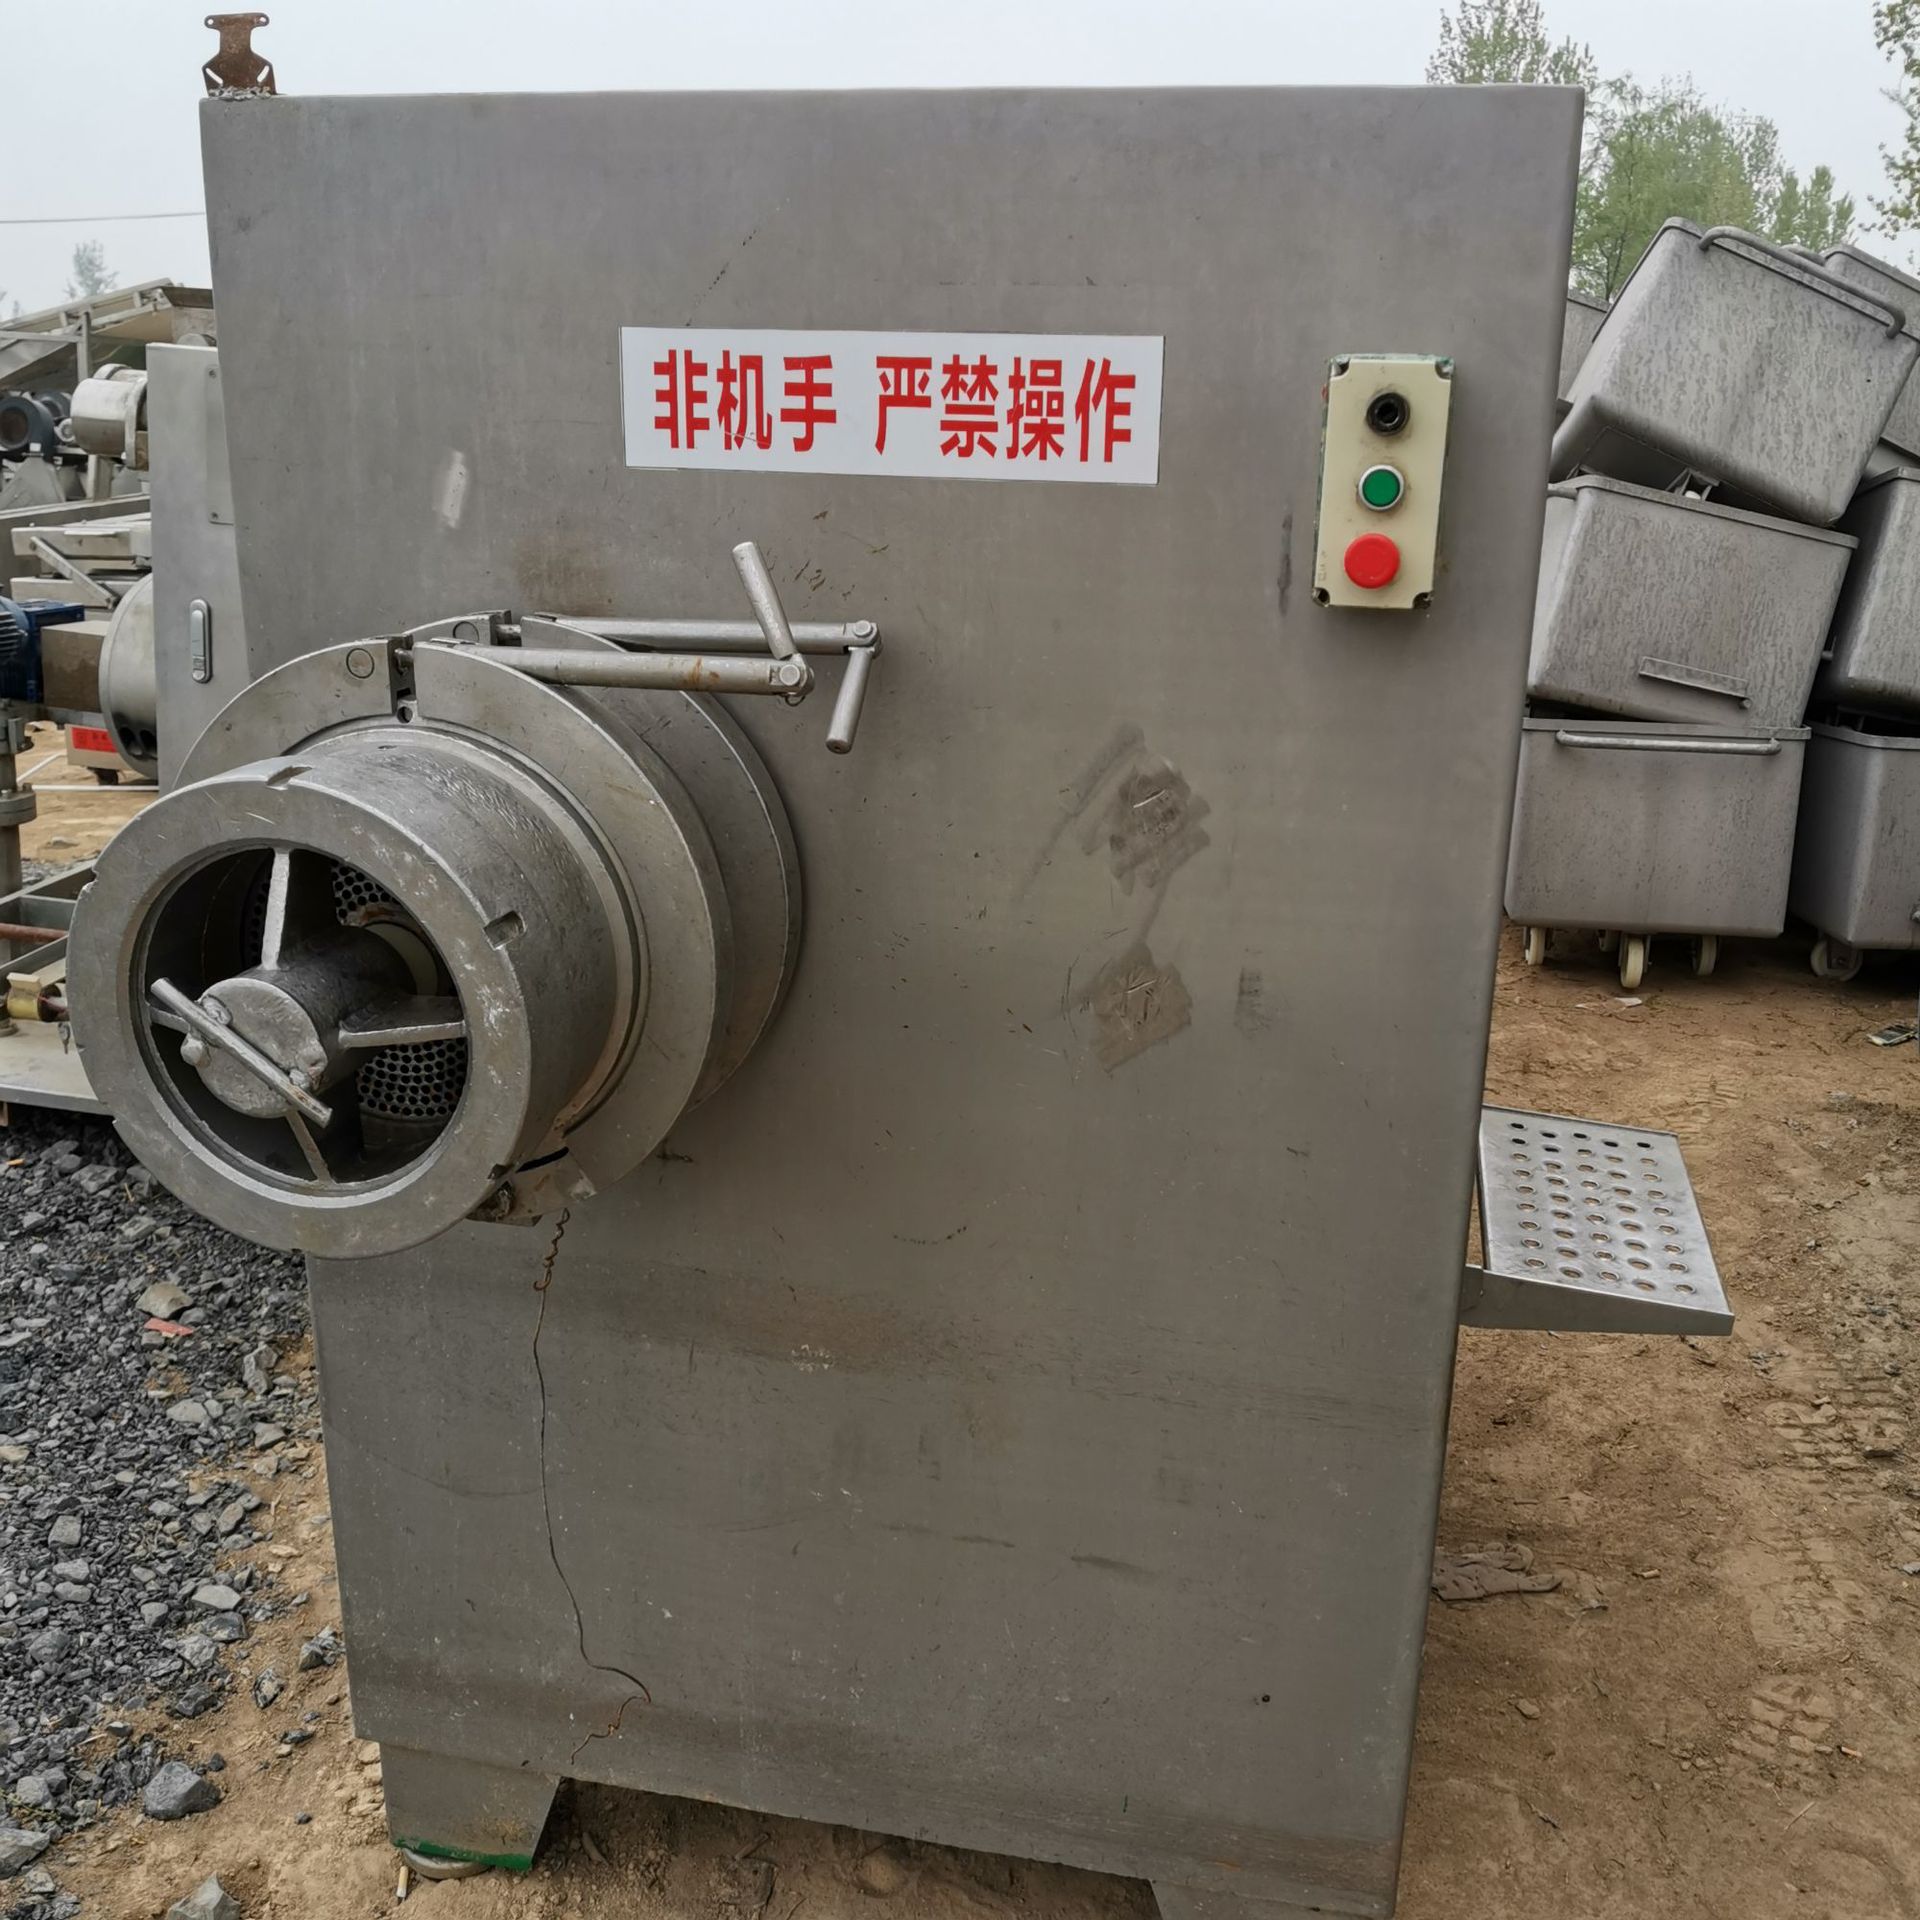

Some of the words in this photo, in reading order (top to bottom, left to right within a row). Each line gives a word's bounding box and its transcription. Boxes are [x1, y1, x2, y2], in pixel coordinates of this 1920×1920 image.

[653, 350, 836, 452] 非机手
[876, 355, 1136, 463] 严禁操作
